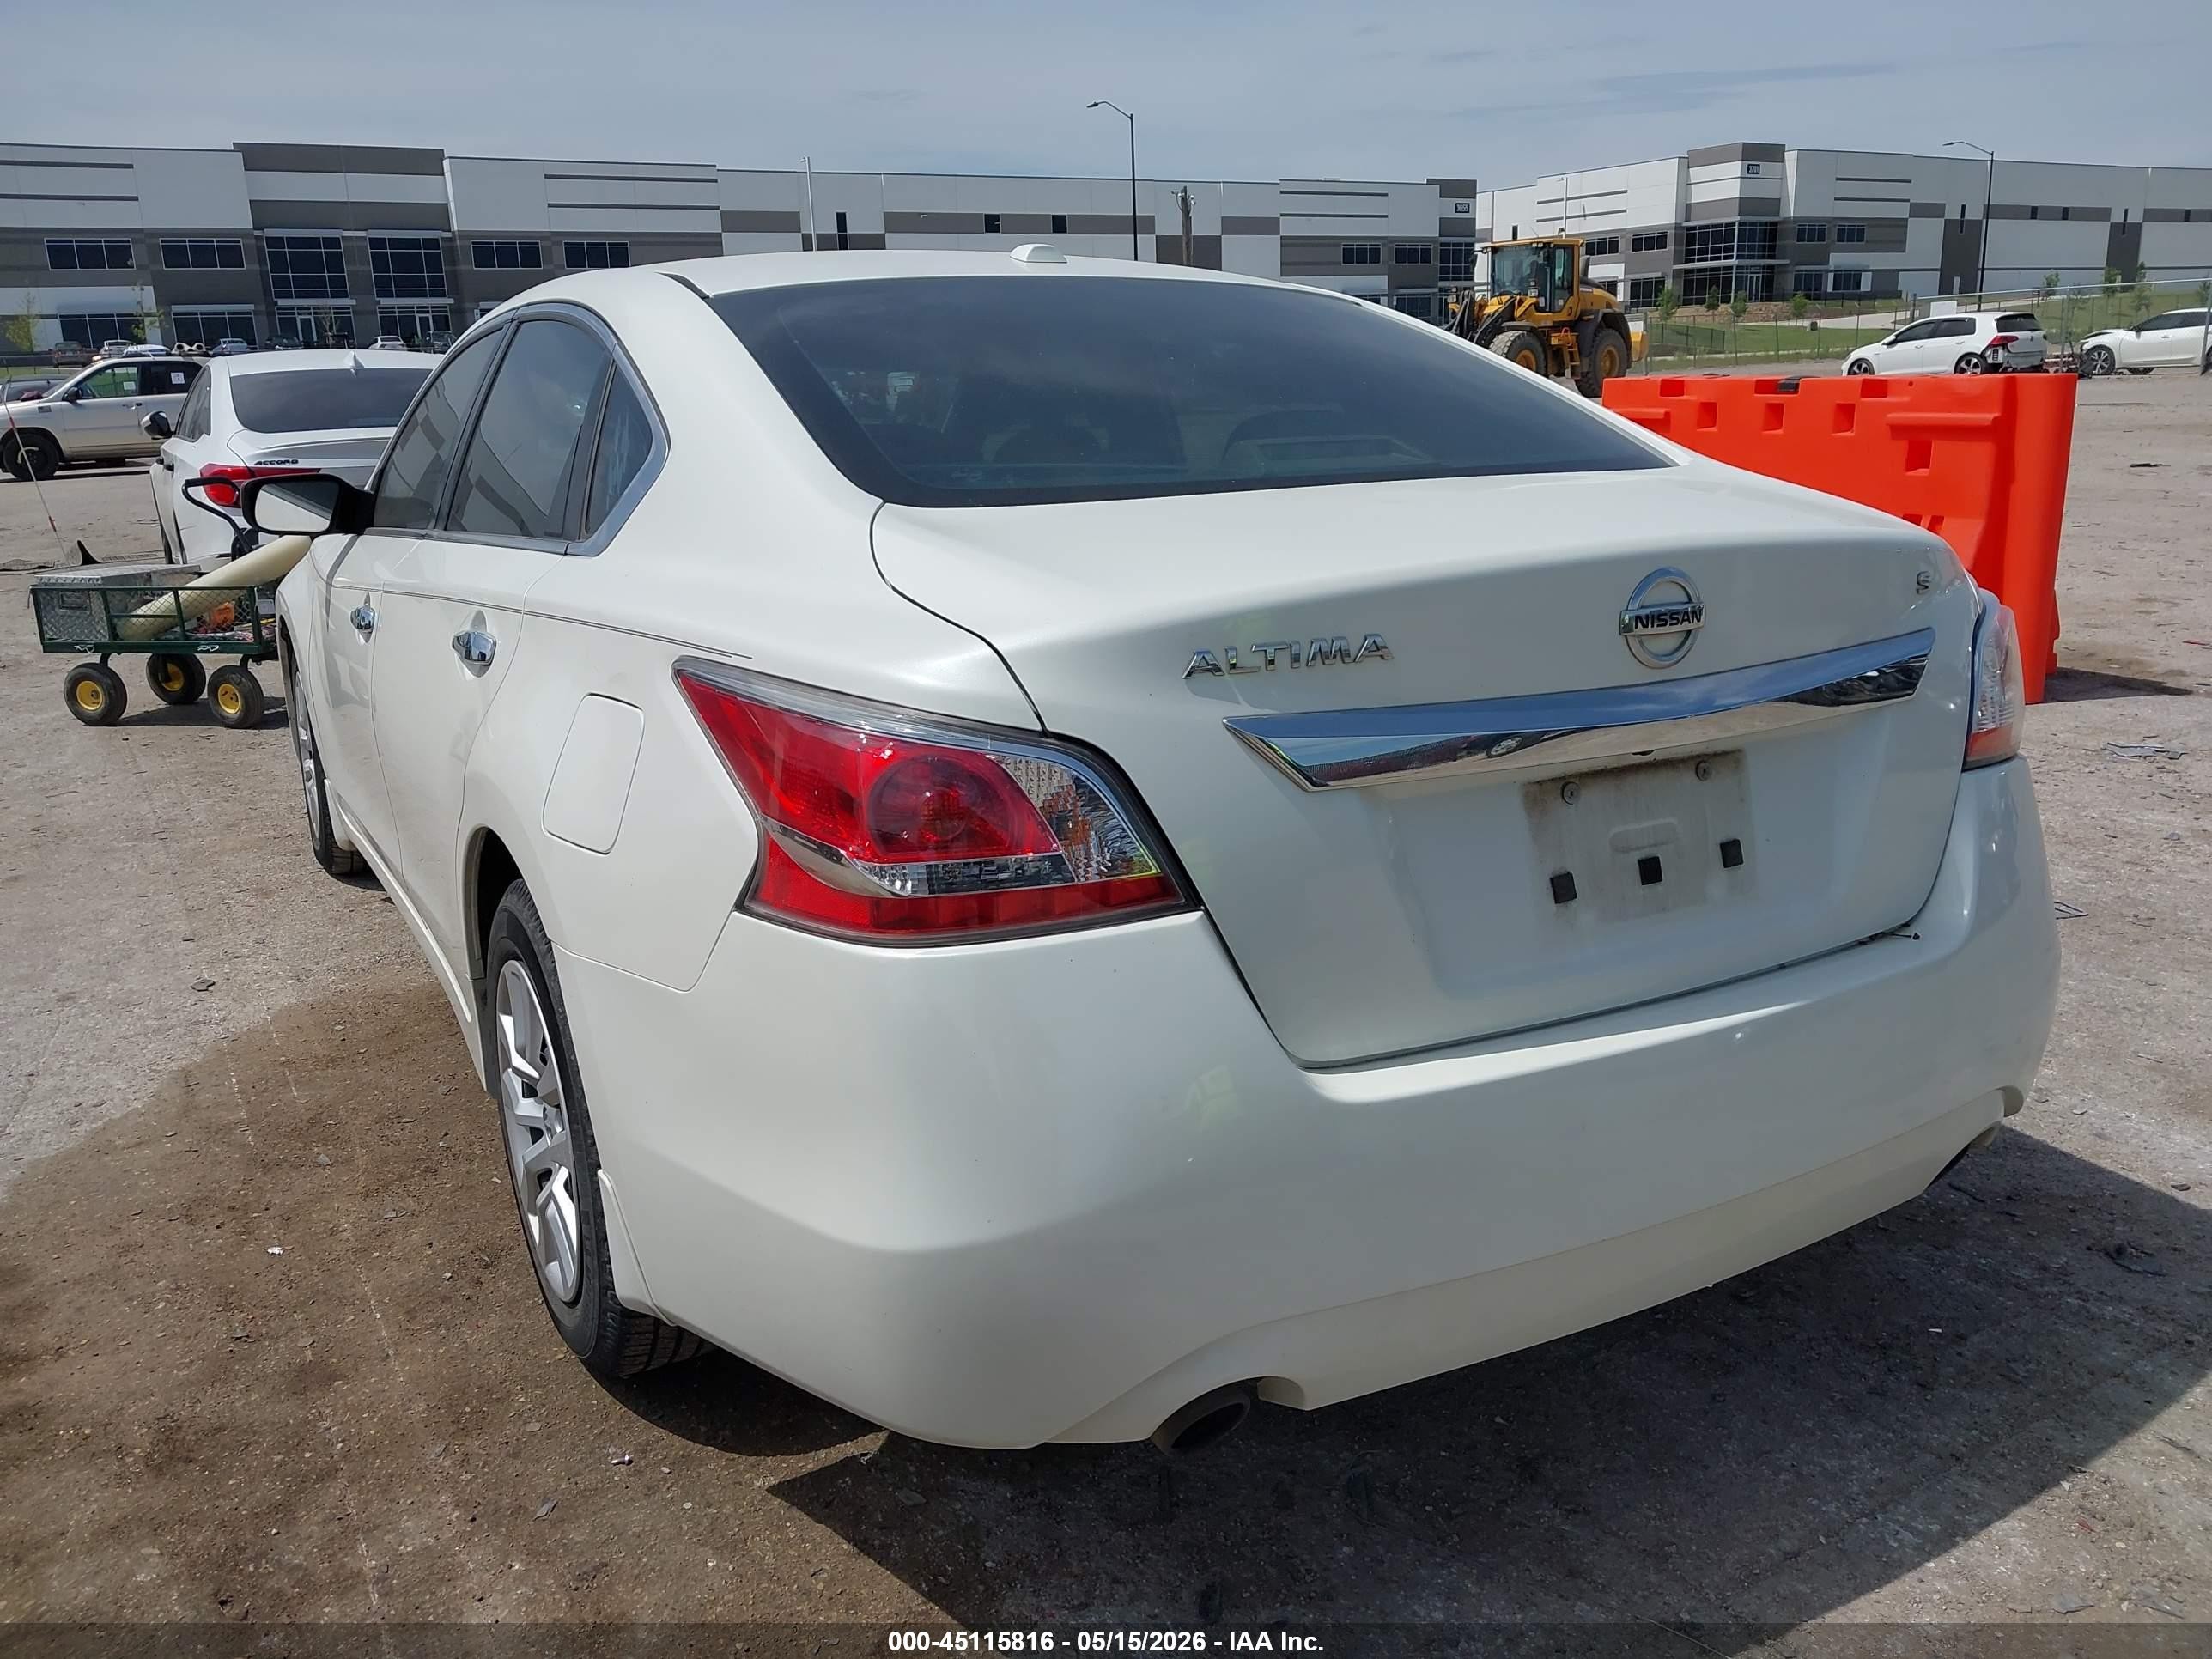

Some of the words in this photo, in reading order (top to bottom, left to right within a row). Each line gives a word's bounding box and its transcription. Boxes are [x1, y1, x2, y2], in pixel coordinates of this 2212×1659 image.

[1916, 570, 1932, 595] S
[1634, 605, 1704, 629] NISSAN
[1182, 634, 1394, 679] ALTIMA
